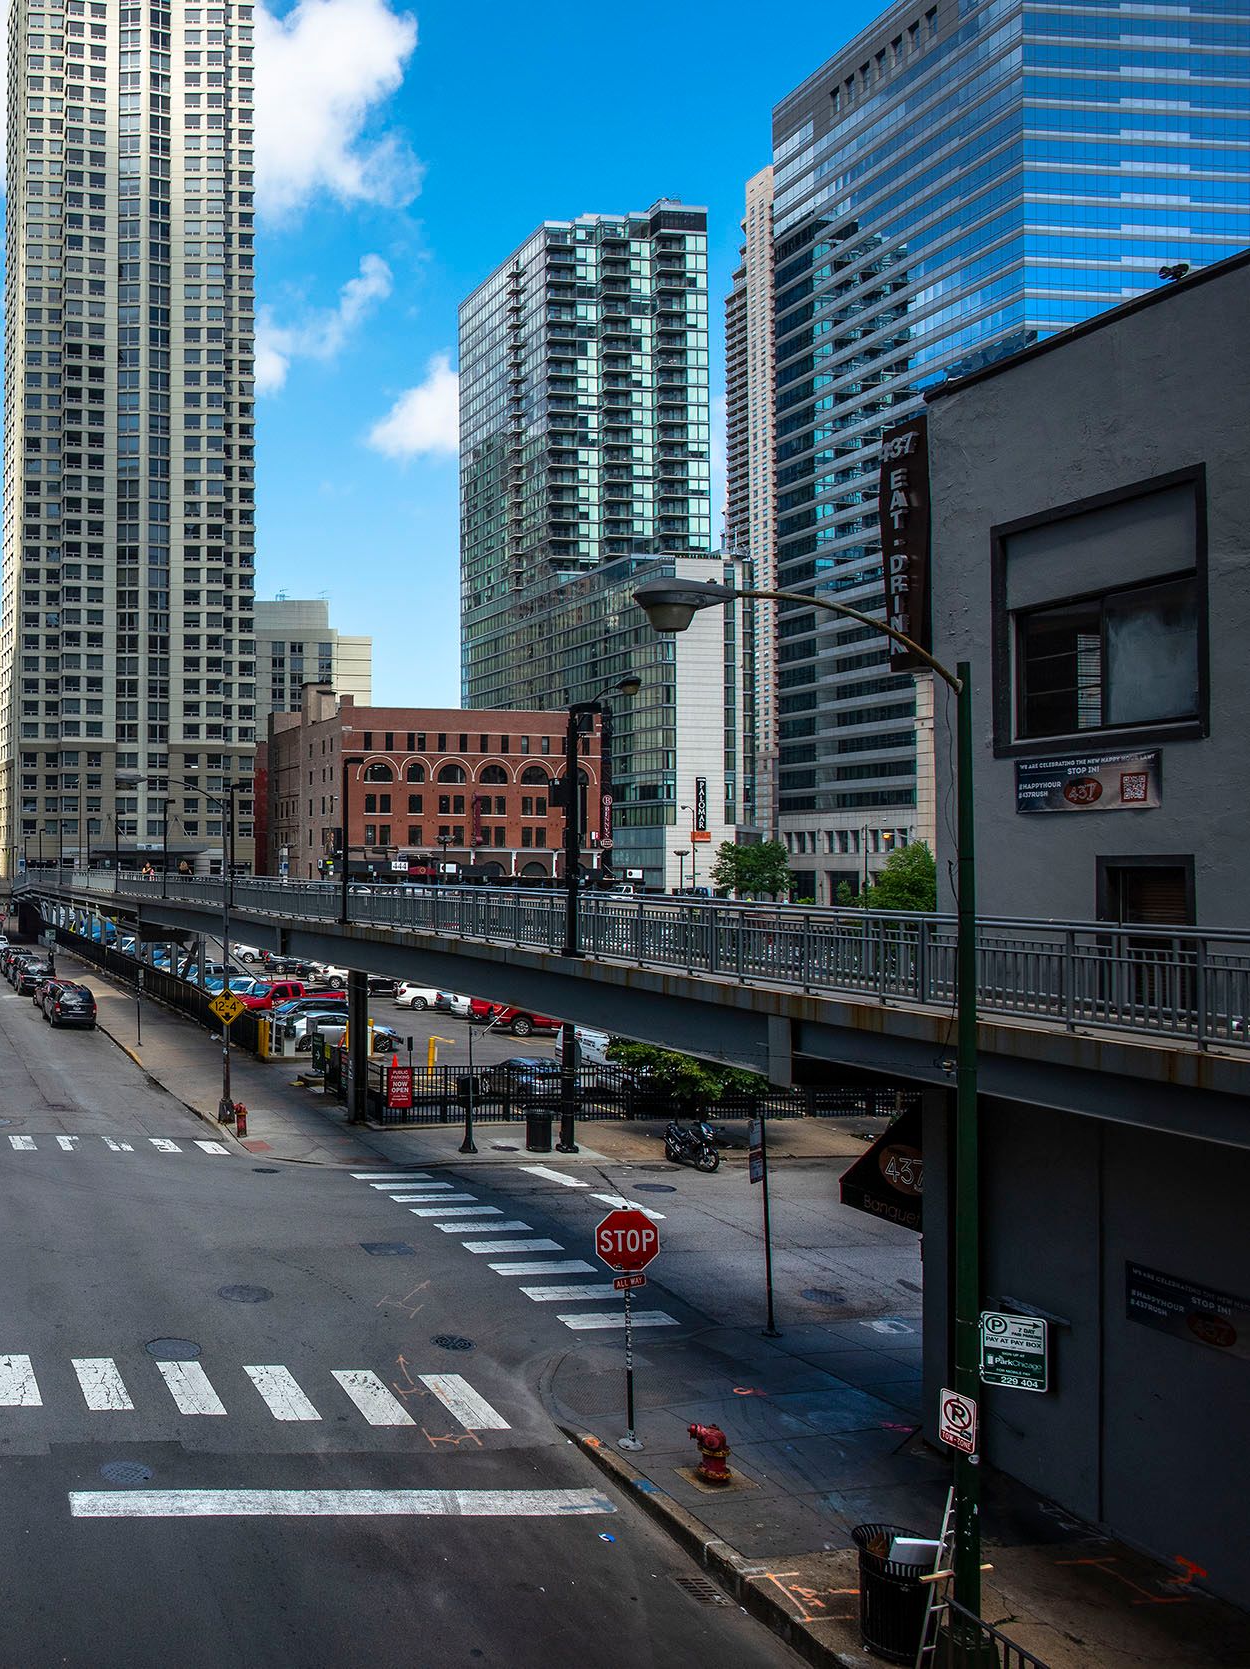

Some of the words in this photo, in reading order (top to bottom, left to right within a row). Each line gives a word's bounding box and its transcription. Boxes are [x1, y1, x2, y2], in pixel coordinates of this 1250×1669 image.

[878, 432, 920, 462] 437
[1039, 760, 1075, 768] CELEBRATING
[1067, 767, 1087, 775] STOP
[1069, 783, 1098, 801] 437
[863, 1194, 920, 1225] Banque
[600, 1229, 655, 1252] STOP
[616, 1280, 629, 1288] ALL
[630, 1276, 643, 1285] WAY
[1191, 1296, 1215, 1309] STOP
[1025, 1341, 1042, 1349] BOX
[994, 1355, 1042, 1370] ParkChicago
[1000, 1376, 1018, 1386] 229
[1020, 1379, 1038, 1388] 404
[942, 1430, 972, 1451] TOW-ZONE
